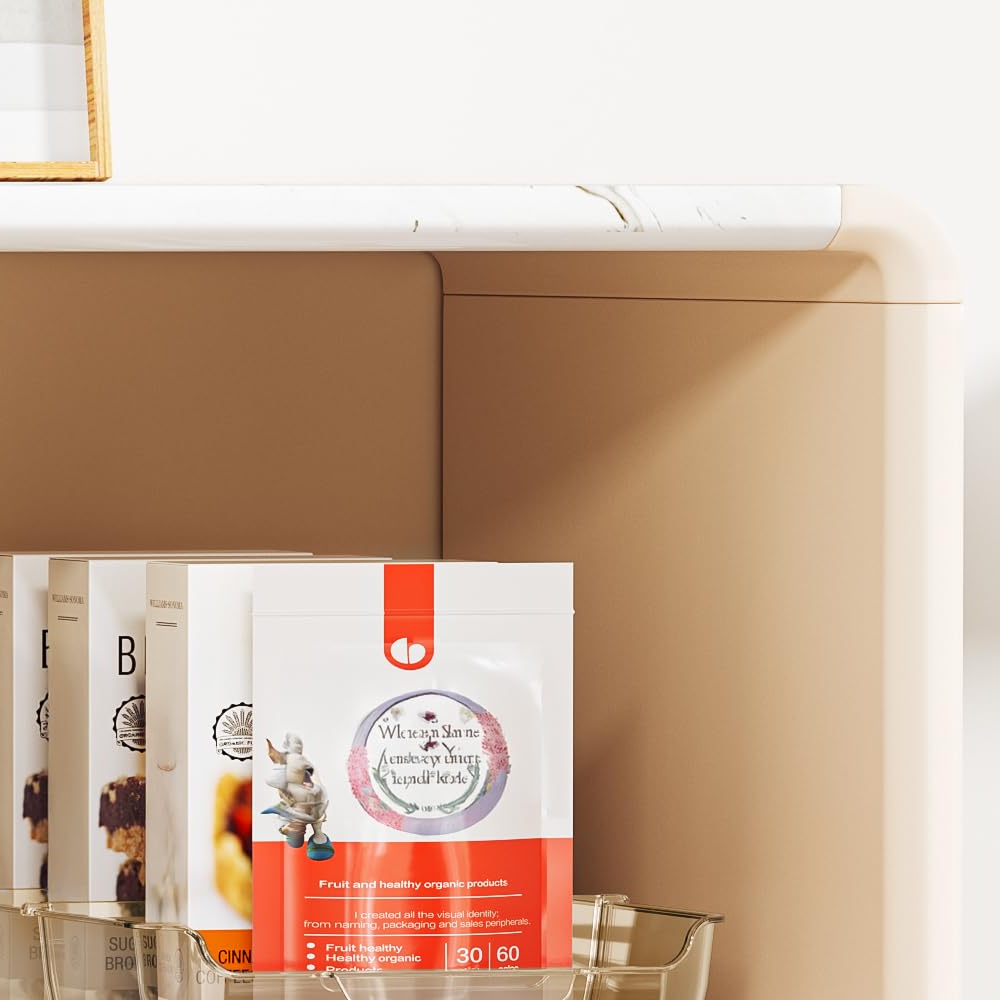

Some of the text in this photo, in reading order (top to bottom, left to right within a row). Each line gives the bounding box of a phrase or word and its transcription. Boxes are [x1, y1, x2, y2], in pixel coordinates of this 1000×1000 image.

[319, 879, 509, 890] Fruit and healthy organic products
[360, 911, 401, 919] created
[404, 911, 415, 919] all
[418, 911, 434, 919] the
[437, 910, 464, 919] visual
[303, 917, 531, 931] from naming, packaging and sales peripherals.
[325, 943, 403, 954] Fruit healthy
[496, 945, 520, 962] 60
[325, 954, 422, 964] Healthy organic
[456, 947, 483, 964] 30
